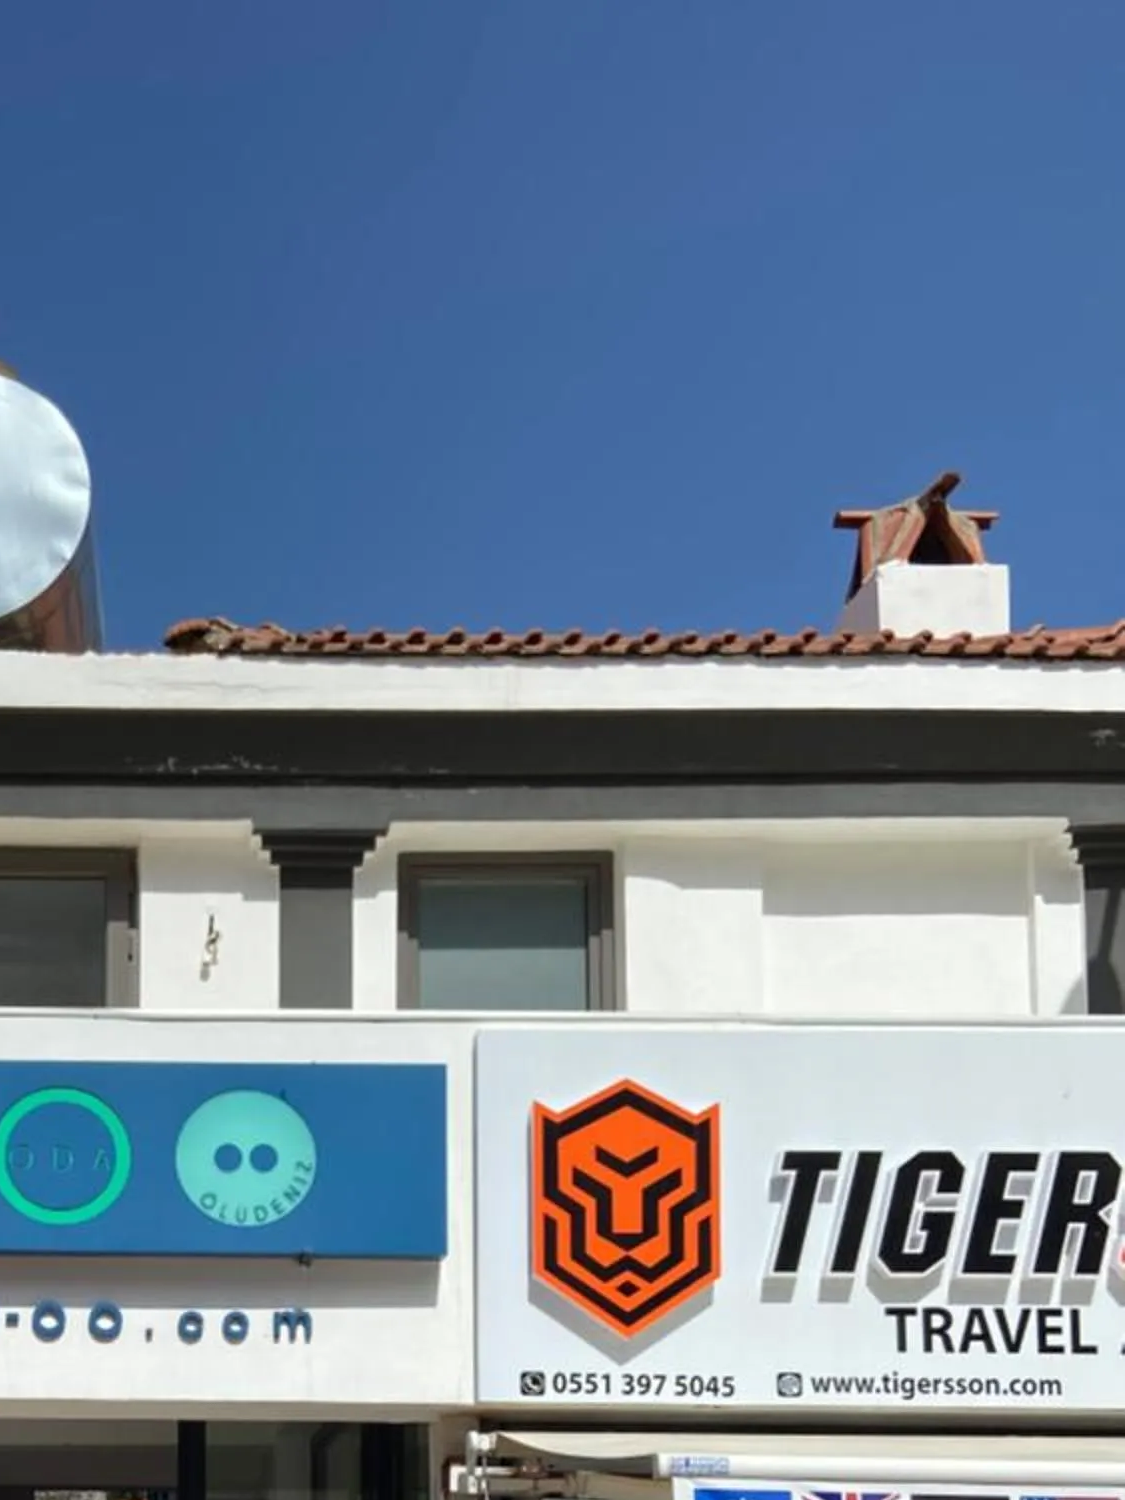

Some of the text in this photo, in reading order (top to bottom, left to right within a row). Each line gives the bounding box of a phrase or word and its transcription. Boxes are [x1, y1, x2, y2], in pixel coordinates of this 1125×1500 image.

[8, 1145, 112, 1172] ODA
[768, 1150, 1125, 1278] TIGER
[885, 1307, 1098, 1354] TRAVEL
[553, 1373, 735, 1397] 0551 397 5045
[811, 1371, 1062, 1400] www.tigersson.com
